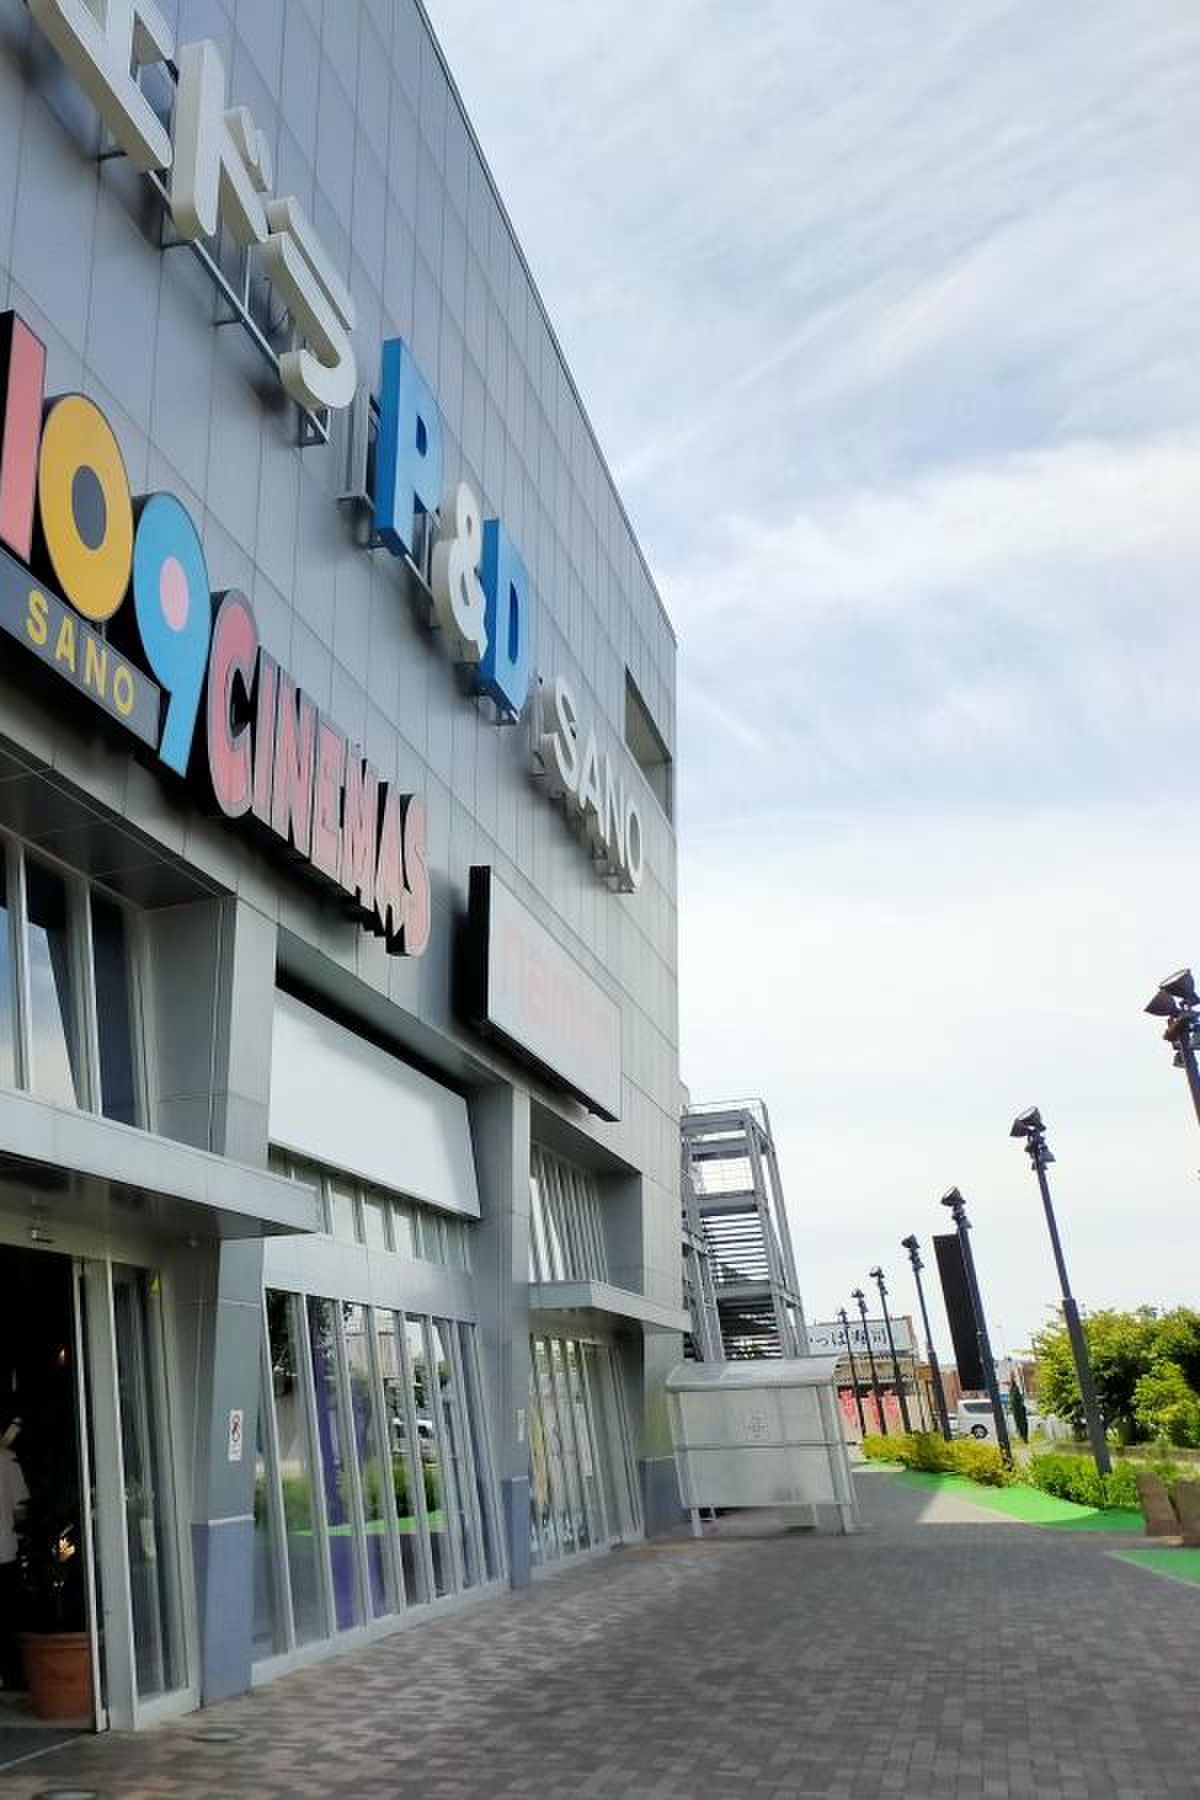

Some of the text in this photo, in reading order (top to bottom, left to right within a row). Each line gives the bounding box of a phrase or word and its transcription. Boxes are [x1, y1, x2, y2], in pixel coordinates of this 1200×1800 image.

[26, 588, 134, 718] SANO
[207, 588, 433, 957] CINEMAS
[541, 675, 642, 890] SANO
